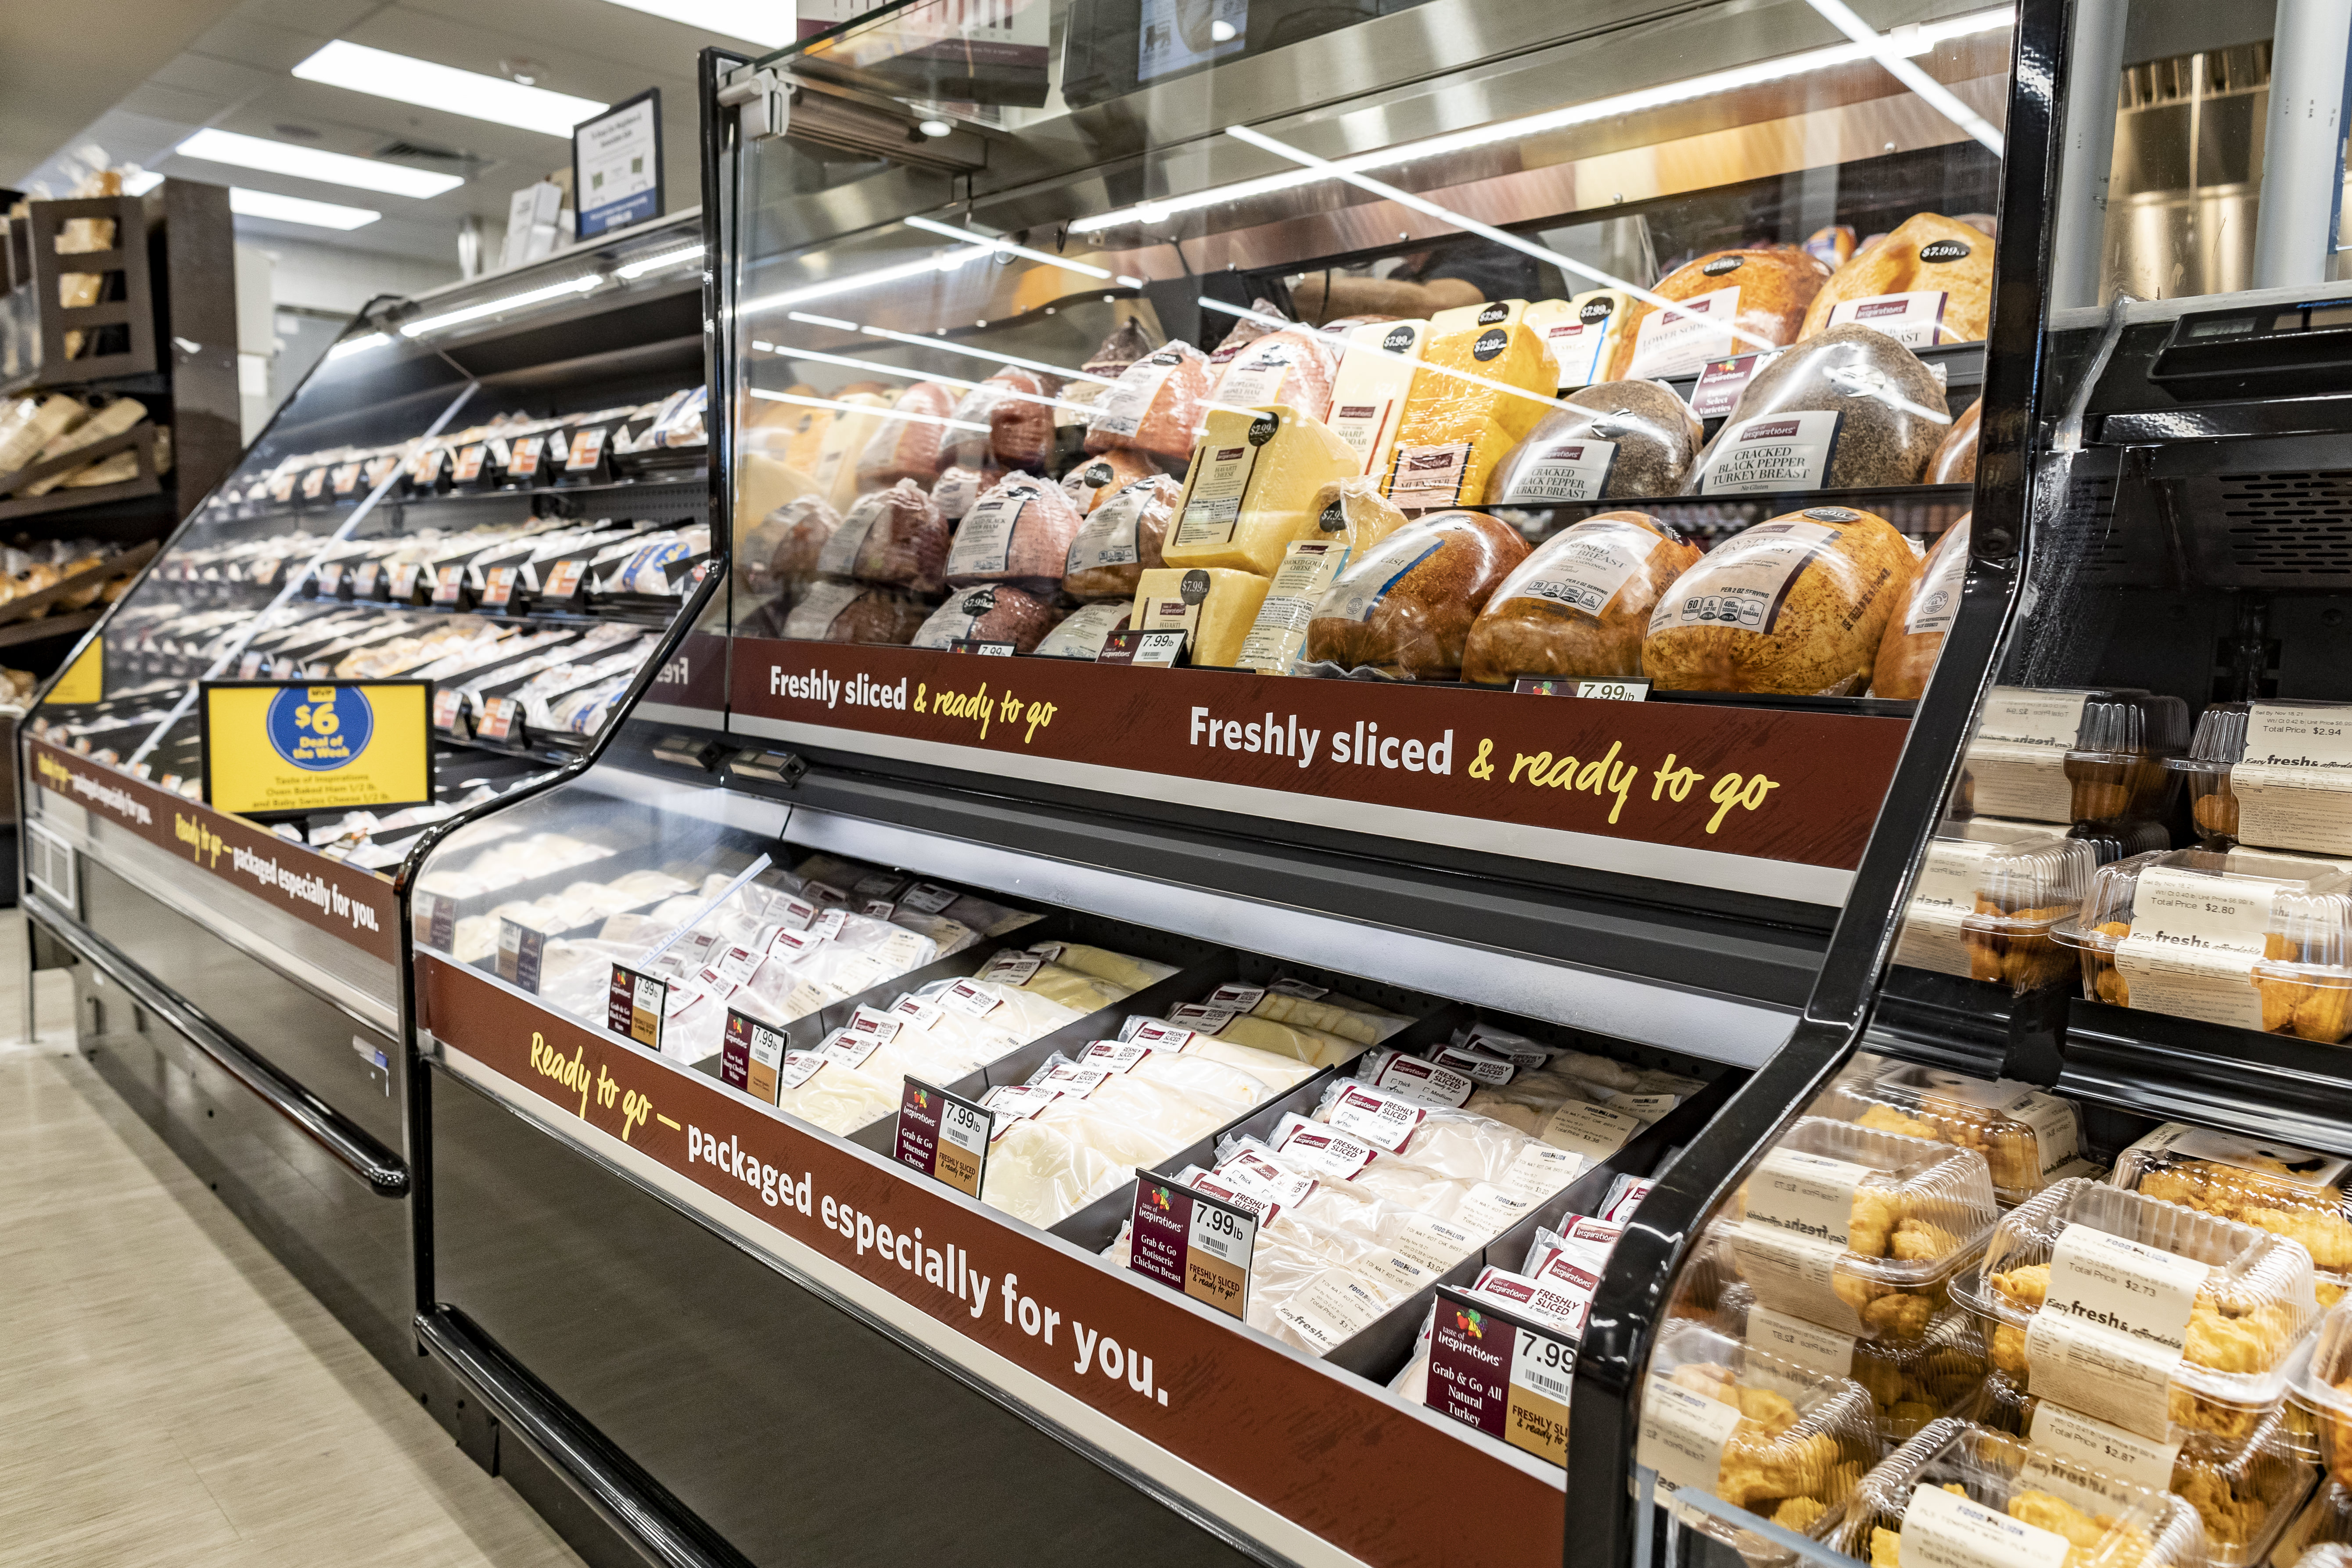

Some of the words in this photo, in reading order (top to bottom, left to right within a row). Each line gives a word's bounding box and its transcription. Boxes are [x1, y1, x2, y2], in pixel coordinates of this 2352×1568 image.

[1384, 335, 1409, 348] $7.99
[1734, 447, 1792, 461] CRACKED
[1718, 460, 1755, 473] BLACK
[1757, 457, 1806, 470] PEPPER
[1713, 470, 1758, 485] TURKEY
[1759, 468, 1810, 480] BREAST
[1547, 487, 1587, 499] BREAST
[1576, 550, 1627, 568] BREAST
[1181, 581, 1203, 592] $7.99
[1745, 589, 1770, 599] SERVING
[1688, 600, 1698, 609] 60
[770, 665, 840, 709] Freshly
[845, 672, 907, 711] sliced
[913, 682, 927, 714] &
[932, 682, 995, 740] ready
[1001, 689, 1024, 723] to
[1026, 700, 1058, 744] go
[295, 702, 340, 735] $6
[300, 736, 328, 747] Deal
[330, 735, 344, 747] of
[292, 748, 313, 759] the
[316, 746, 350, 758] Week
[1190, 706, 1321, 769] Freshly
[1331, 721, 1454, 775] sliced
[1469, 738, 1495, 781] &
[1508, 741, 1637, 824] ready
[1651, 753, 1705, 802] to
[1709, 772, 1780, 833] go
[233, 846, 277, 885] packaged
[278, 868, 330, 915] especially
[332, 883, 350, 918] for
[352, 900, 379, 932] you.
[2151, 897, 2173, 906] Total
[2175, 900, 2198, 909] Price
[2205, 903, 2235, 915] $2.80
[1433, 1075, 1461, 1090] SLICED
[1434, 1069, 1469, 1086] FRESHLY
[1430, 1090, 1453, 1102] Medium
[1382, 1108, 1408, 1121] SLICED
[1384, 1101, 1415, 1116] FRESHLY
[902, 1128, 916, 1141] Grab
[916, 1135, 923, 1145] &
[924, 1137, 932, 1149] Go
[1332, 1138, 1366, 1155] FRESHLY
[903, 1140, 929, 1159] Muenster
[1331, 1145, 1357, 1158] SLICED
[905, 1153, 925, 1170] Cheese
[939, 1152, 959, 1166] FRESHLY
[960, 1162, 975, 1175] SLICED
[945, 1164, 959, 1178] ready
[1239, 1173, 1252, 1184] Thick
[1235, 1192, 1268, 1210] FRESHLY
[531, 1031, 591, 1120] Ready
[596, 1064, 620, 1109] to
[622, 1089, 653, 1141] go
[688, 1124, 812, 1217] packaged
[821, 1195, 991, 1318] especially
[1002, 1273, 1060, 1346] for
[1072, 1320, 1168, 1407] you.
[1141, 1234, 1157, 1248] Grab
[1158, 1242, 1165, 1251] &
[1167, 1245, 1177, 1256] Go
[1142, 1247, 1174, 1267] Rotisserie
[1134, 1255, 1160, 1273] Chicken
[1161, 1267, 1181, 1283] Breast
[1190, 1263, 1217, 1281] FRESHLY
[1217, 1276, 1239, 1292] SLICED
[2068, 1262, 2092, 1275] Total
[2093, 1270, 2117, 1284] Price
[2125, 1280, 2156, 1297] $2.73
[1198, 1278, 1217, 1295] ready
[1218, 1285, 1224, 1294] to
[1224, 1289, 1235, 1300] go!
[1349, 1284, 1364, 1296] FOOD
[1310, 1298, 1323, 1310] Total
[1323, 1307, 1336, 1319] Price
[1535, 1298, 1570, 1316] SLICED
[1537, 1289, 1580, 1310] FRESHLY
[2046, 1298, 2070, 1316] Easy
[1443, 1326, 1457, 1338] taste
[1458, 1331, 1465, 1340] of
[1433, 1362, 1455, 1380] Grab
[1457, 1372, 1467, 1385] &
[1469, 1378, 1483, 1392] Go
[1487, 1386, 1502, 1401] All
[1448, 1385, 1483, 1410] Natural
[1448, 1401, 1480, 1427] Turkey
[1512, 1405, 1552, 1428] FRESHLY
[1554, 1423, 1569, 1437] SLI
[1517, 1418, 1523, 1428] &
[1525, 1421, 1553, 1446] ready
[1554, 1435, 1563, 1445] to
